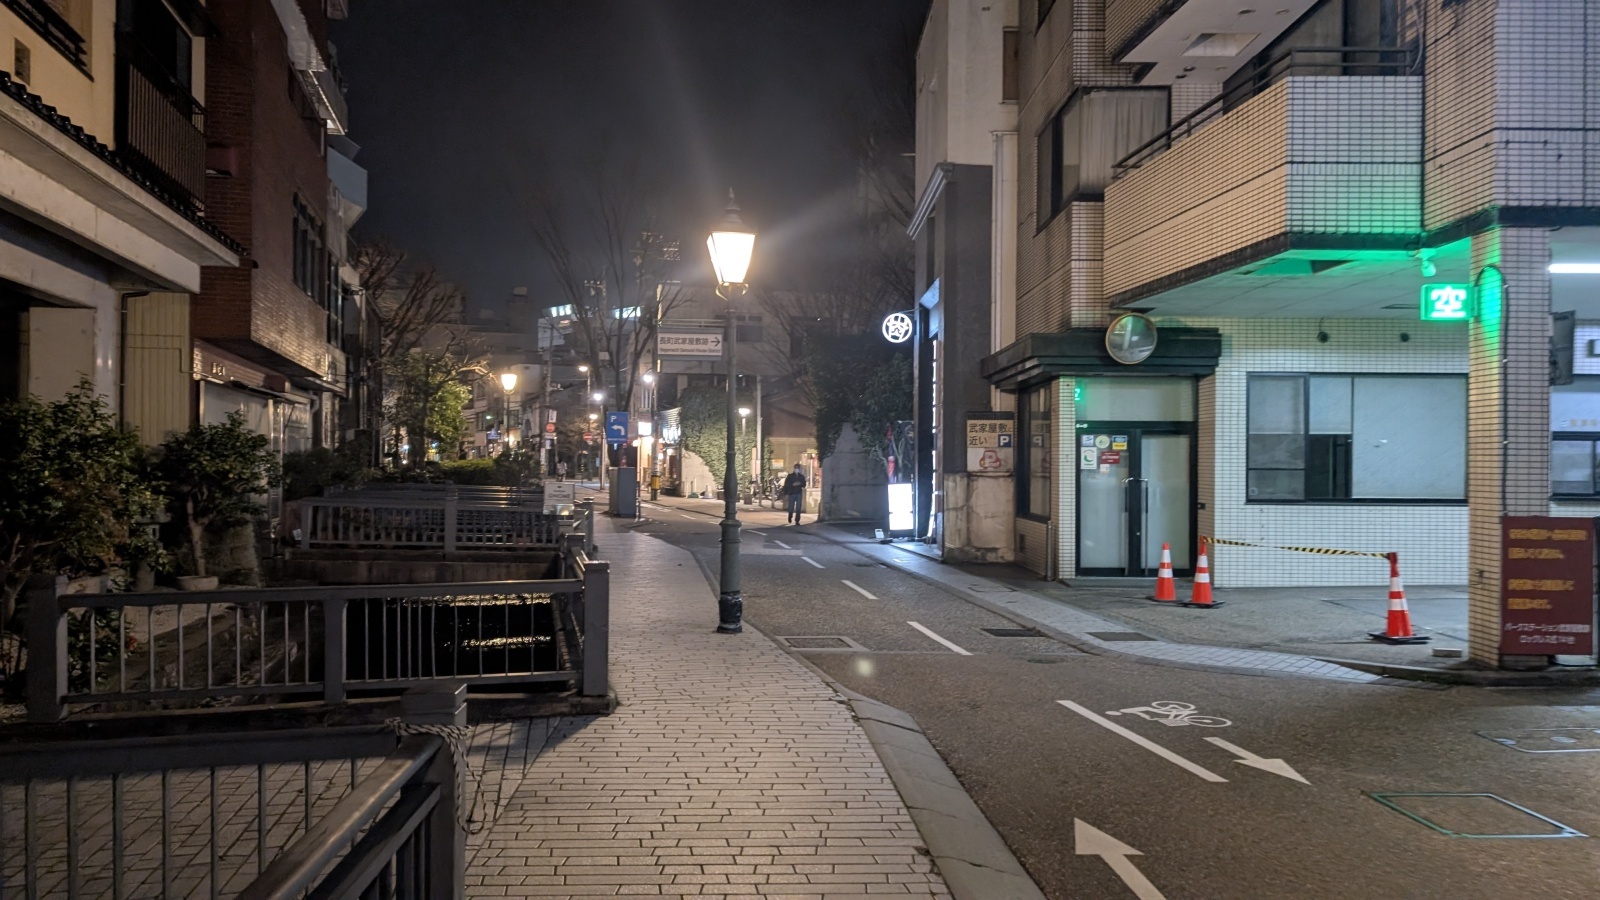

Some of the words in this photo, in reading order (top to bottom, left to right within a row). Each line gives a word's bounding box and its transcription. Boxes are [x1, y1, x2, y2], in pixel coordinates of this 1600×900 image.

[1430, 284, 1467, 319] 空
[659, 337, 709, 346] 長町武家屋敷跡
[610, 415, 617, 423] P
[968, 435, 988, 446] 近い
[999, 435, 1010, 447] P
